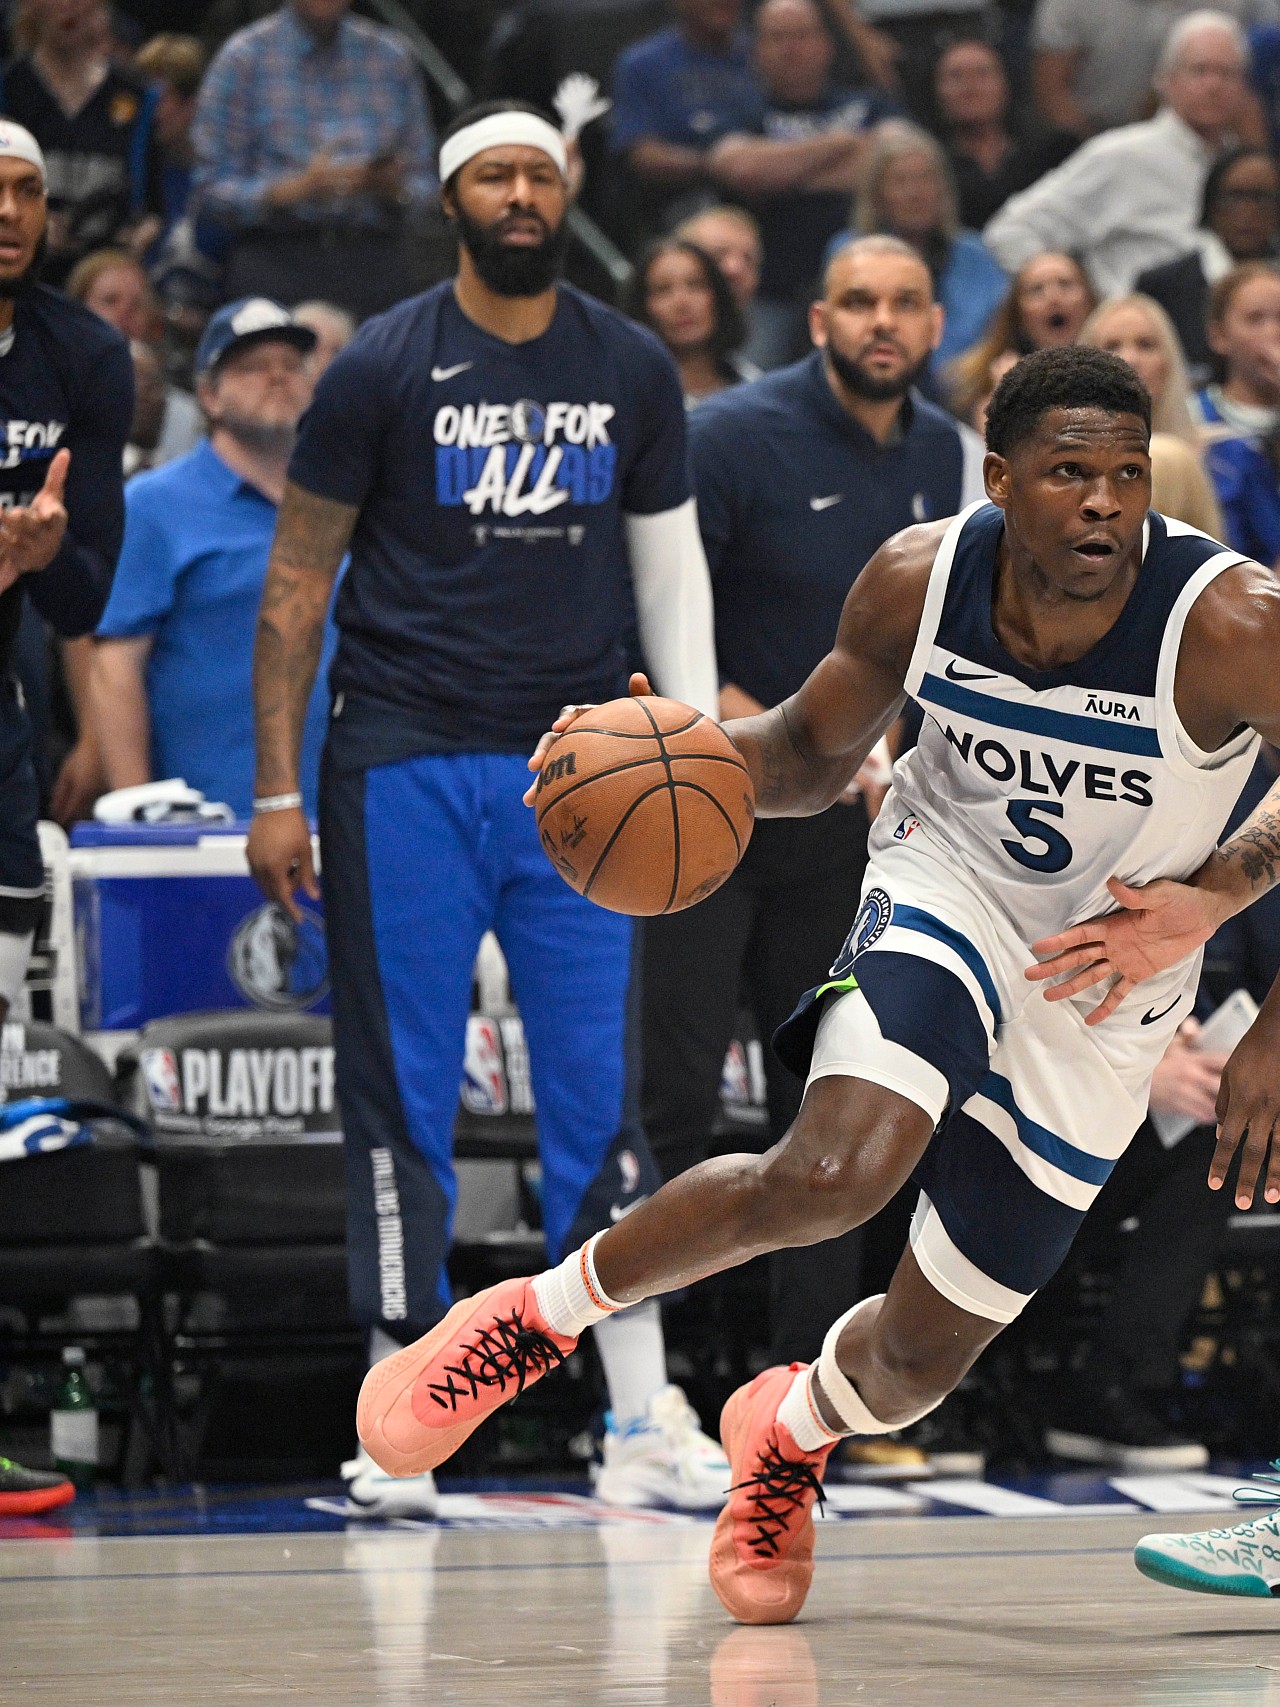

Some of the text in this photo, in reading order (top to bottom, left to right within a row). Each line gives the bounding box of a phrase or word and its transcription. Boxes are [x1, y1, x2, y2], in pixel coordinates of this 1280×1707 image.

[433, 402, 616, 451] ONE FOR
[463, 442, 569, 517] ALL
[1000, 799, 1073, 873] 5
